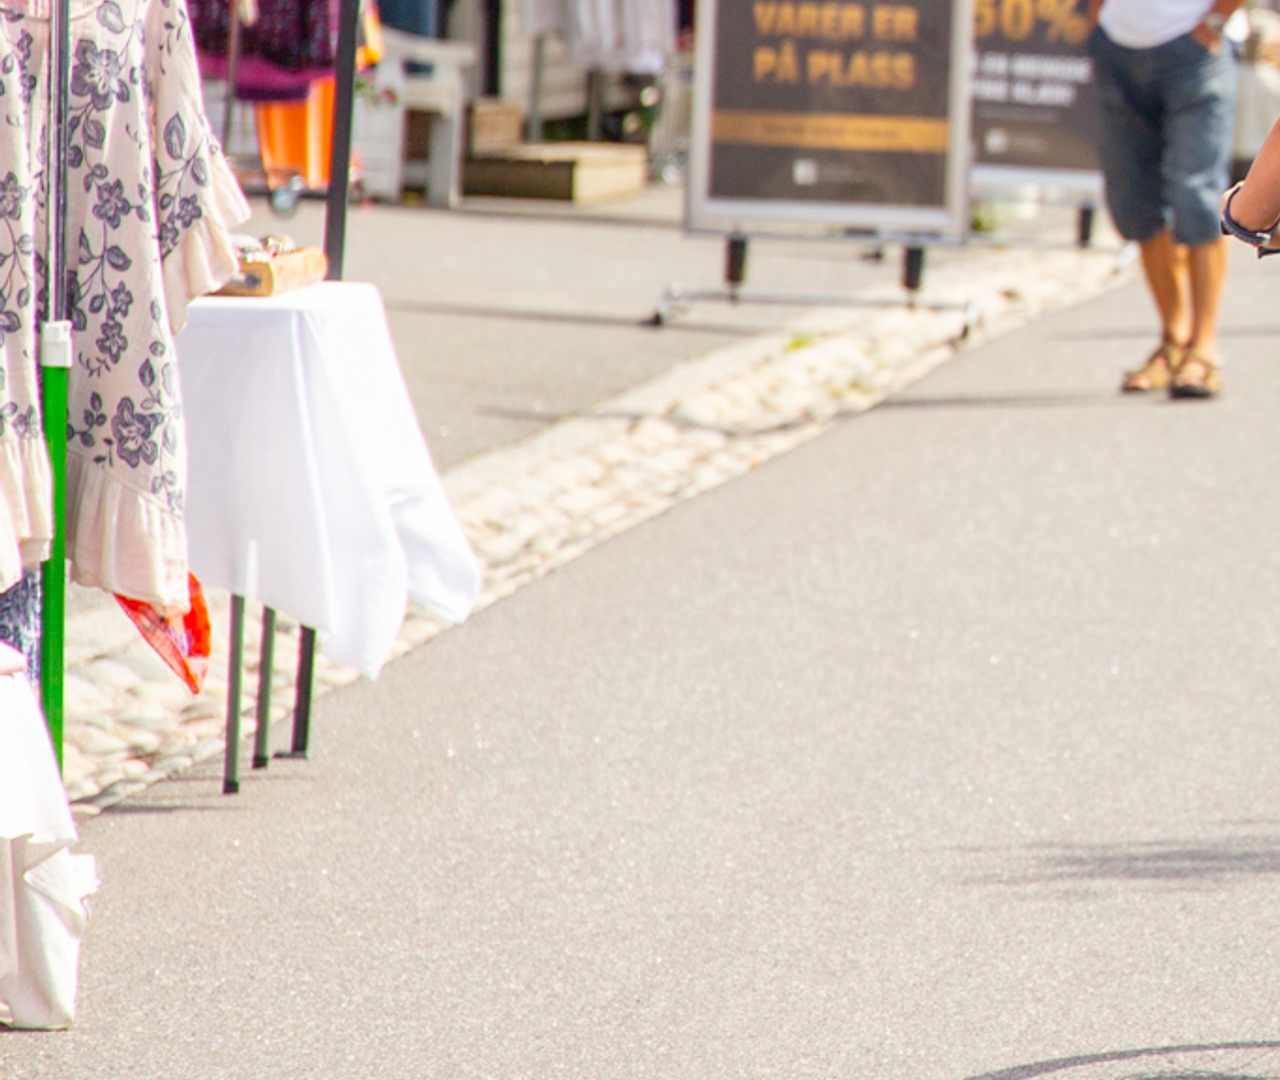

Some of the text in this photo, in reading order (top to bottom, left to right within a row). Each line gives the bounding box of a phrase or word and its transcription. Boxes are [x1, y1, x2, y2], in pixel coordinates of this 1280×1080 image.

[872, 3, 919, 42] ER
[753, 37, 916, 90] PÅ PLASS
